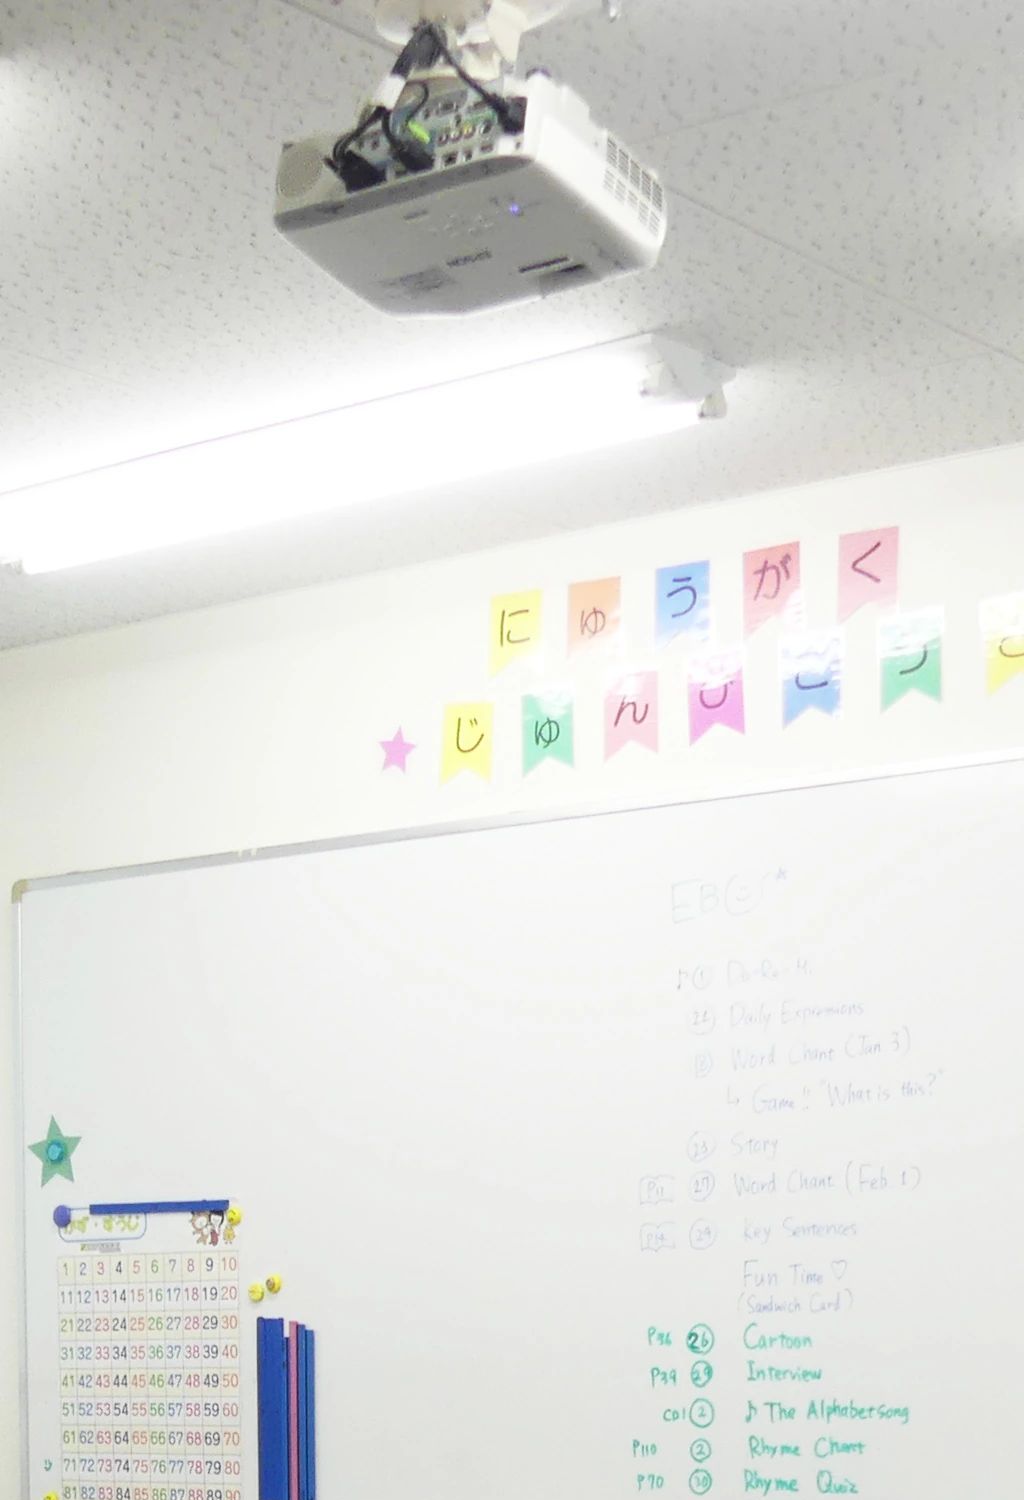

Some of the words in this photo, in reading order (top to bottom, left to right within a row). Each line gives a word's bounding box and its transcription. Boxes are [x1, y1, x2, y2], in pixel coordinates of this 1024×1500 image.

[730, 1000, 771, 1031] Daily
[731, 1042, 776, 1072] Word
[788, 1040, 835, 1066] Chant
[730, 1130, 779, 1160] Story
[733, 1171, 776, 1197] Word
[787, 1168, 835, 1194] Chant
[744, 1217, 771, 1245] Key
[782, 1216, 857, 1238] Sentences
[63, 1263, 68, 1276] 1
[79, 1262, 87, 1276] 2
[97, 1262, 105, 1275] 3
[115, 1261, 122, 1275] 4
[132, 1260, 140, 1274] 5
[151, 1260, 159, 1274] 6
[169, 1259, 176, 1273] 7
[187, 1259, 195, 1273] 8
[205, 1258, 214, 1272] 9
[221, 1257, 237, 1272] 10
[743, 1259, 778, 1287] Fun
[788, 1264, 824, 1286] Time
[61, 1319, 74, 1333] 21
[77, 1319, 92, 1332] 22
[96, 1318, 110, 1332] 23
[113, 1318, 127, 1332] 24
[131, 1318, 146, 1331] 25
[148, 1317, 164, 1331] 26
[167, 1317, 181, 1331] 27
[184, 1316, 200, 1330] 28
[202, 1316, 218, 1330] 29
[222, 1316, 238, 1330] 30
[743, 1323, 813, 1350] Cartoon
[747, 1360, 823, 1383] Interview
[764, 1400, 796, 1420] The
[63, 1430, 76, 1444] 61
[79, 1431, 94, 1444] 62
[97, 1431, 112, 1445] 63
[114, 1431, 130, 1445] 64
[132, 1431, 148, 1445] 65
[150, 1431, 166, 1445] 66
[168, 1431, 184, 1445] 67
[187, 1432, 202, 1446] 68
[205, 1432, 221, 1446] 69
[224, 1432, 240, 1446] 70
[750, 1434, 801, 1459] Rhyme
[743, 1468, 799, 1496] Rhyme
[816, 1470, 859, 1495] Quiz
